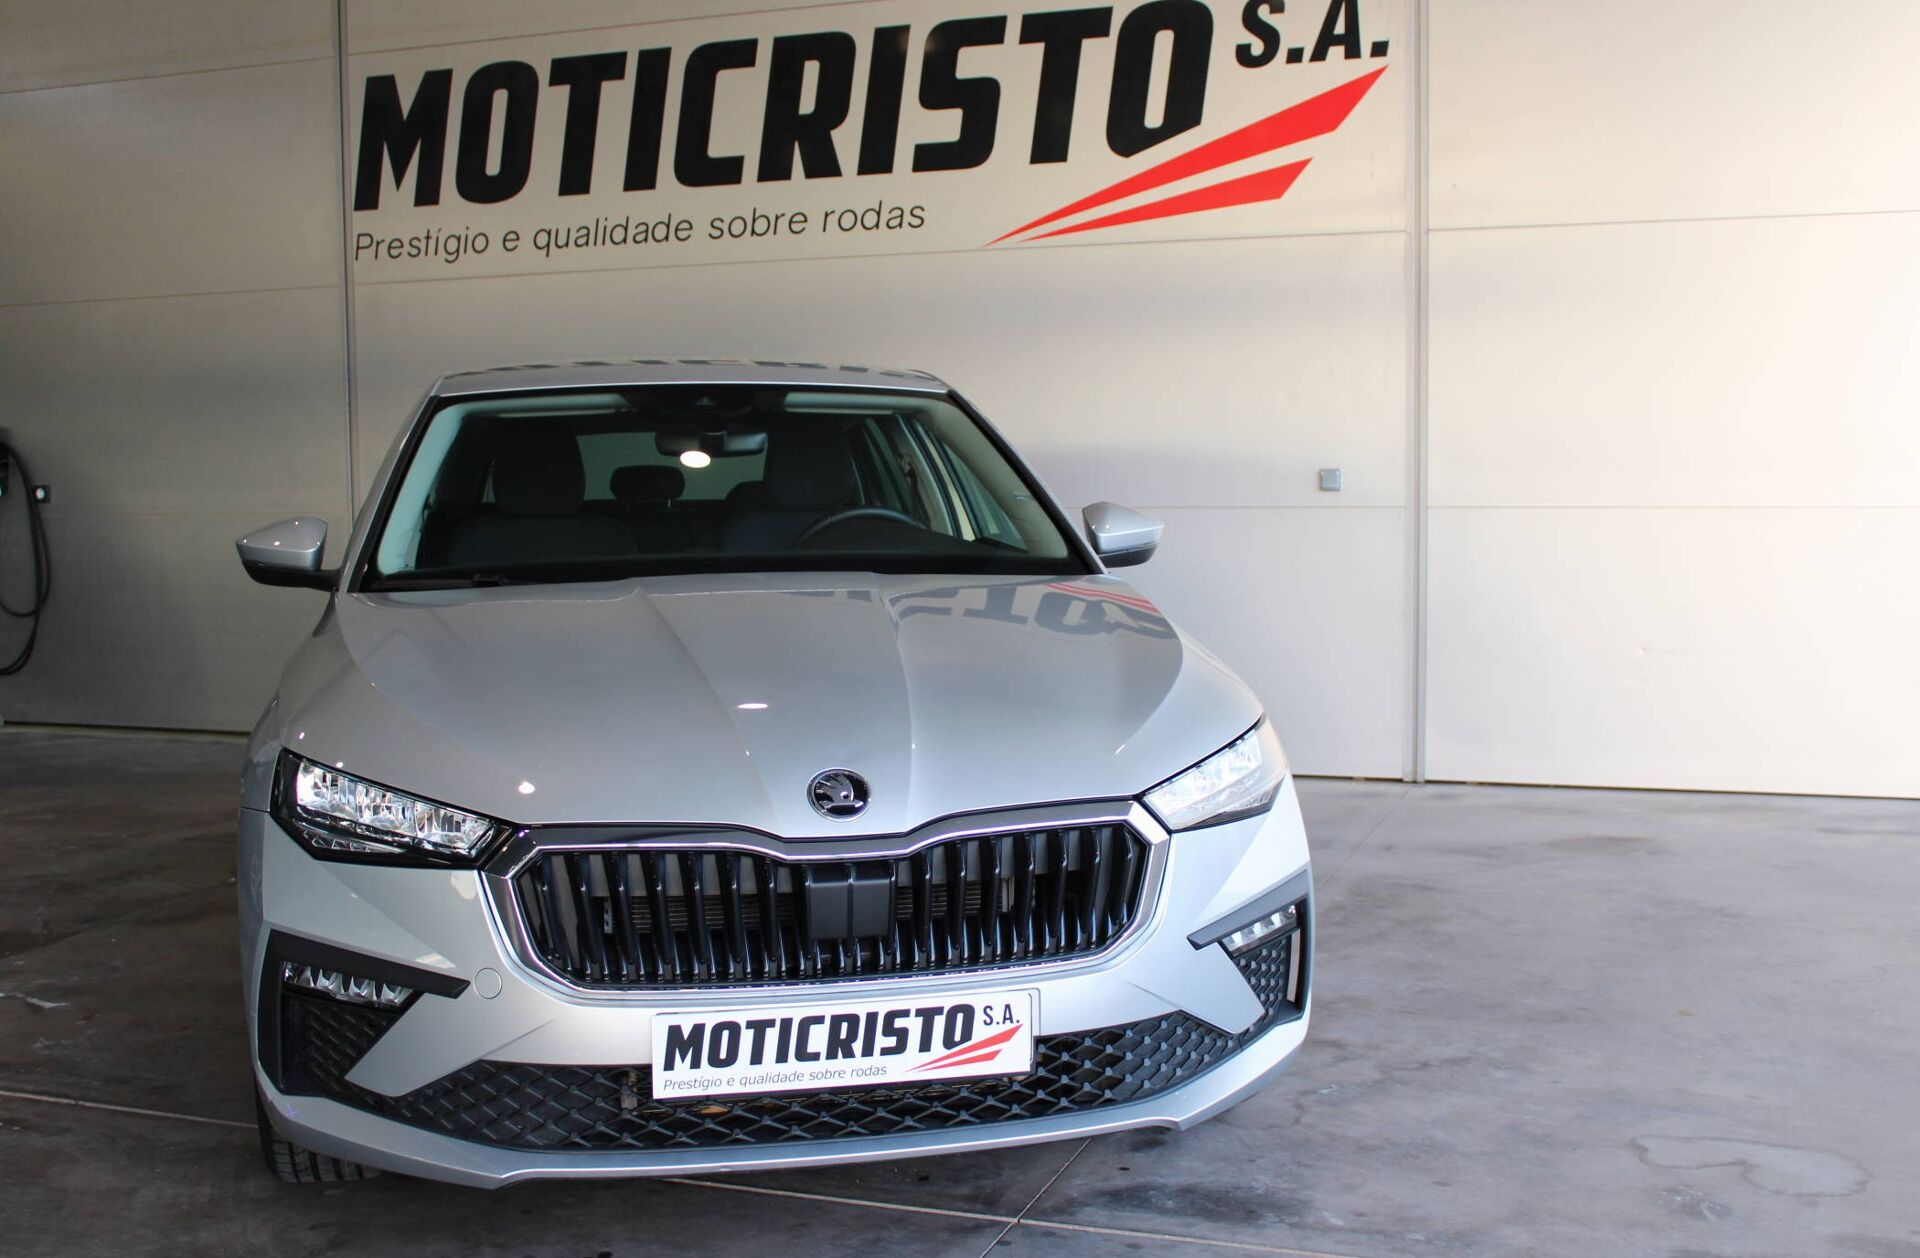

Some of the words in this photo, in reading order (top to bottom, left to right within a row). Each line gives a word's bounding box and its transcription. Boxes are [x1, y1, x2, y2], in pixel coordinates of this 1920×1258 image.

[353, 0, 1214, 212] MOTICRISTO
[1235, 0, 1390, 69] S.A.
[354, 226, 490, 264] Prestígio
[502, 226, 520, 253] e
[533, 213, 694, 258] qualidade
[708, 207, 808, 240] sobre
[822, 200, 925, 233] rodas
[663, 1003, 976, 1072] MOTICRISTO
[982, 1003, 1021, 1026] S.A.
[663, 1075, 723, 1092] Prestígio
[726, 1076, 736, 1087] e
[739, 1071, 804, 1089] qualidade
[808, 1067, 846, 1081] sobre
[850, 1064, 887, 1078] rodas
